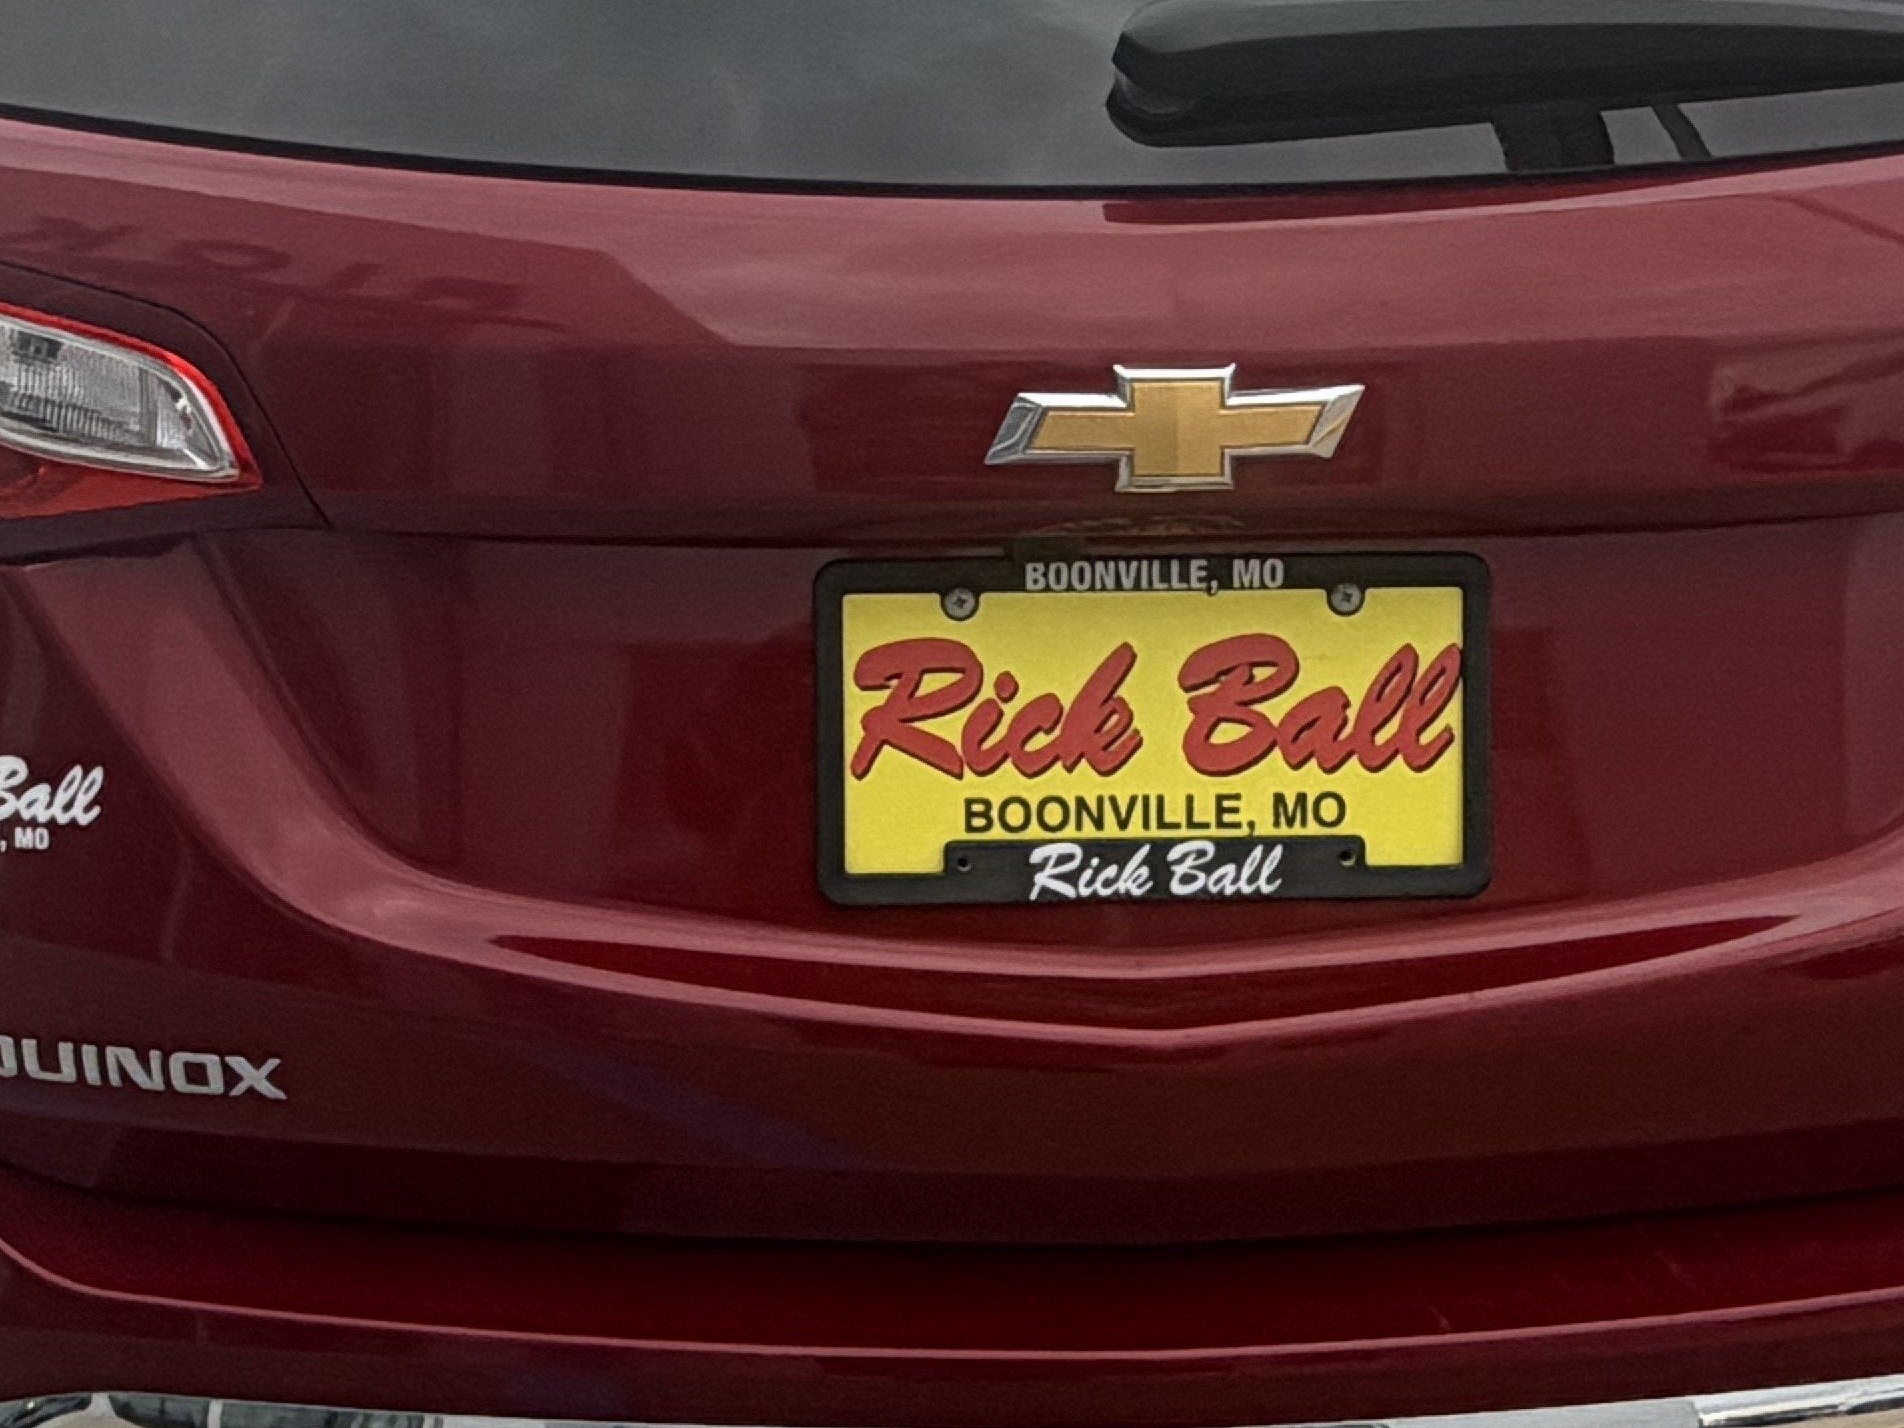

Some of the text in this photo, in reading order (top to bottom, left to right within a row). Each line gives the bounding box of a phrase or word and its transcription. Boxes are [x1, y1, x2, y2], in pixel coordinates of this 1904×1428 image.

[1025, 558, 1284, 593] BOONVILLE, MO
[850, 633, 1462, 779] Rick Ball
[964, 792, 1347, 837] BOONVILLE, MO
[15, 827, 49, 850] MO
[1030, 840, 1283, 900] Rick Ball
